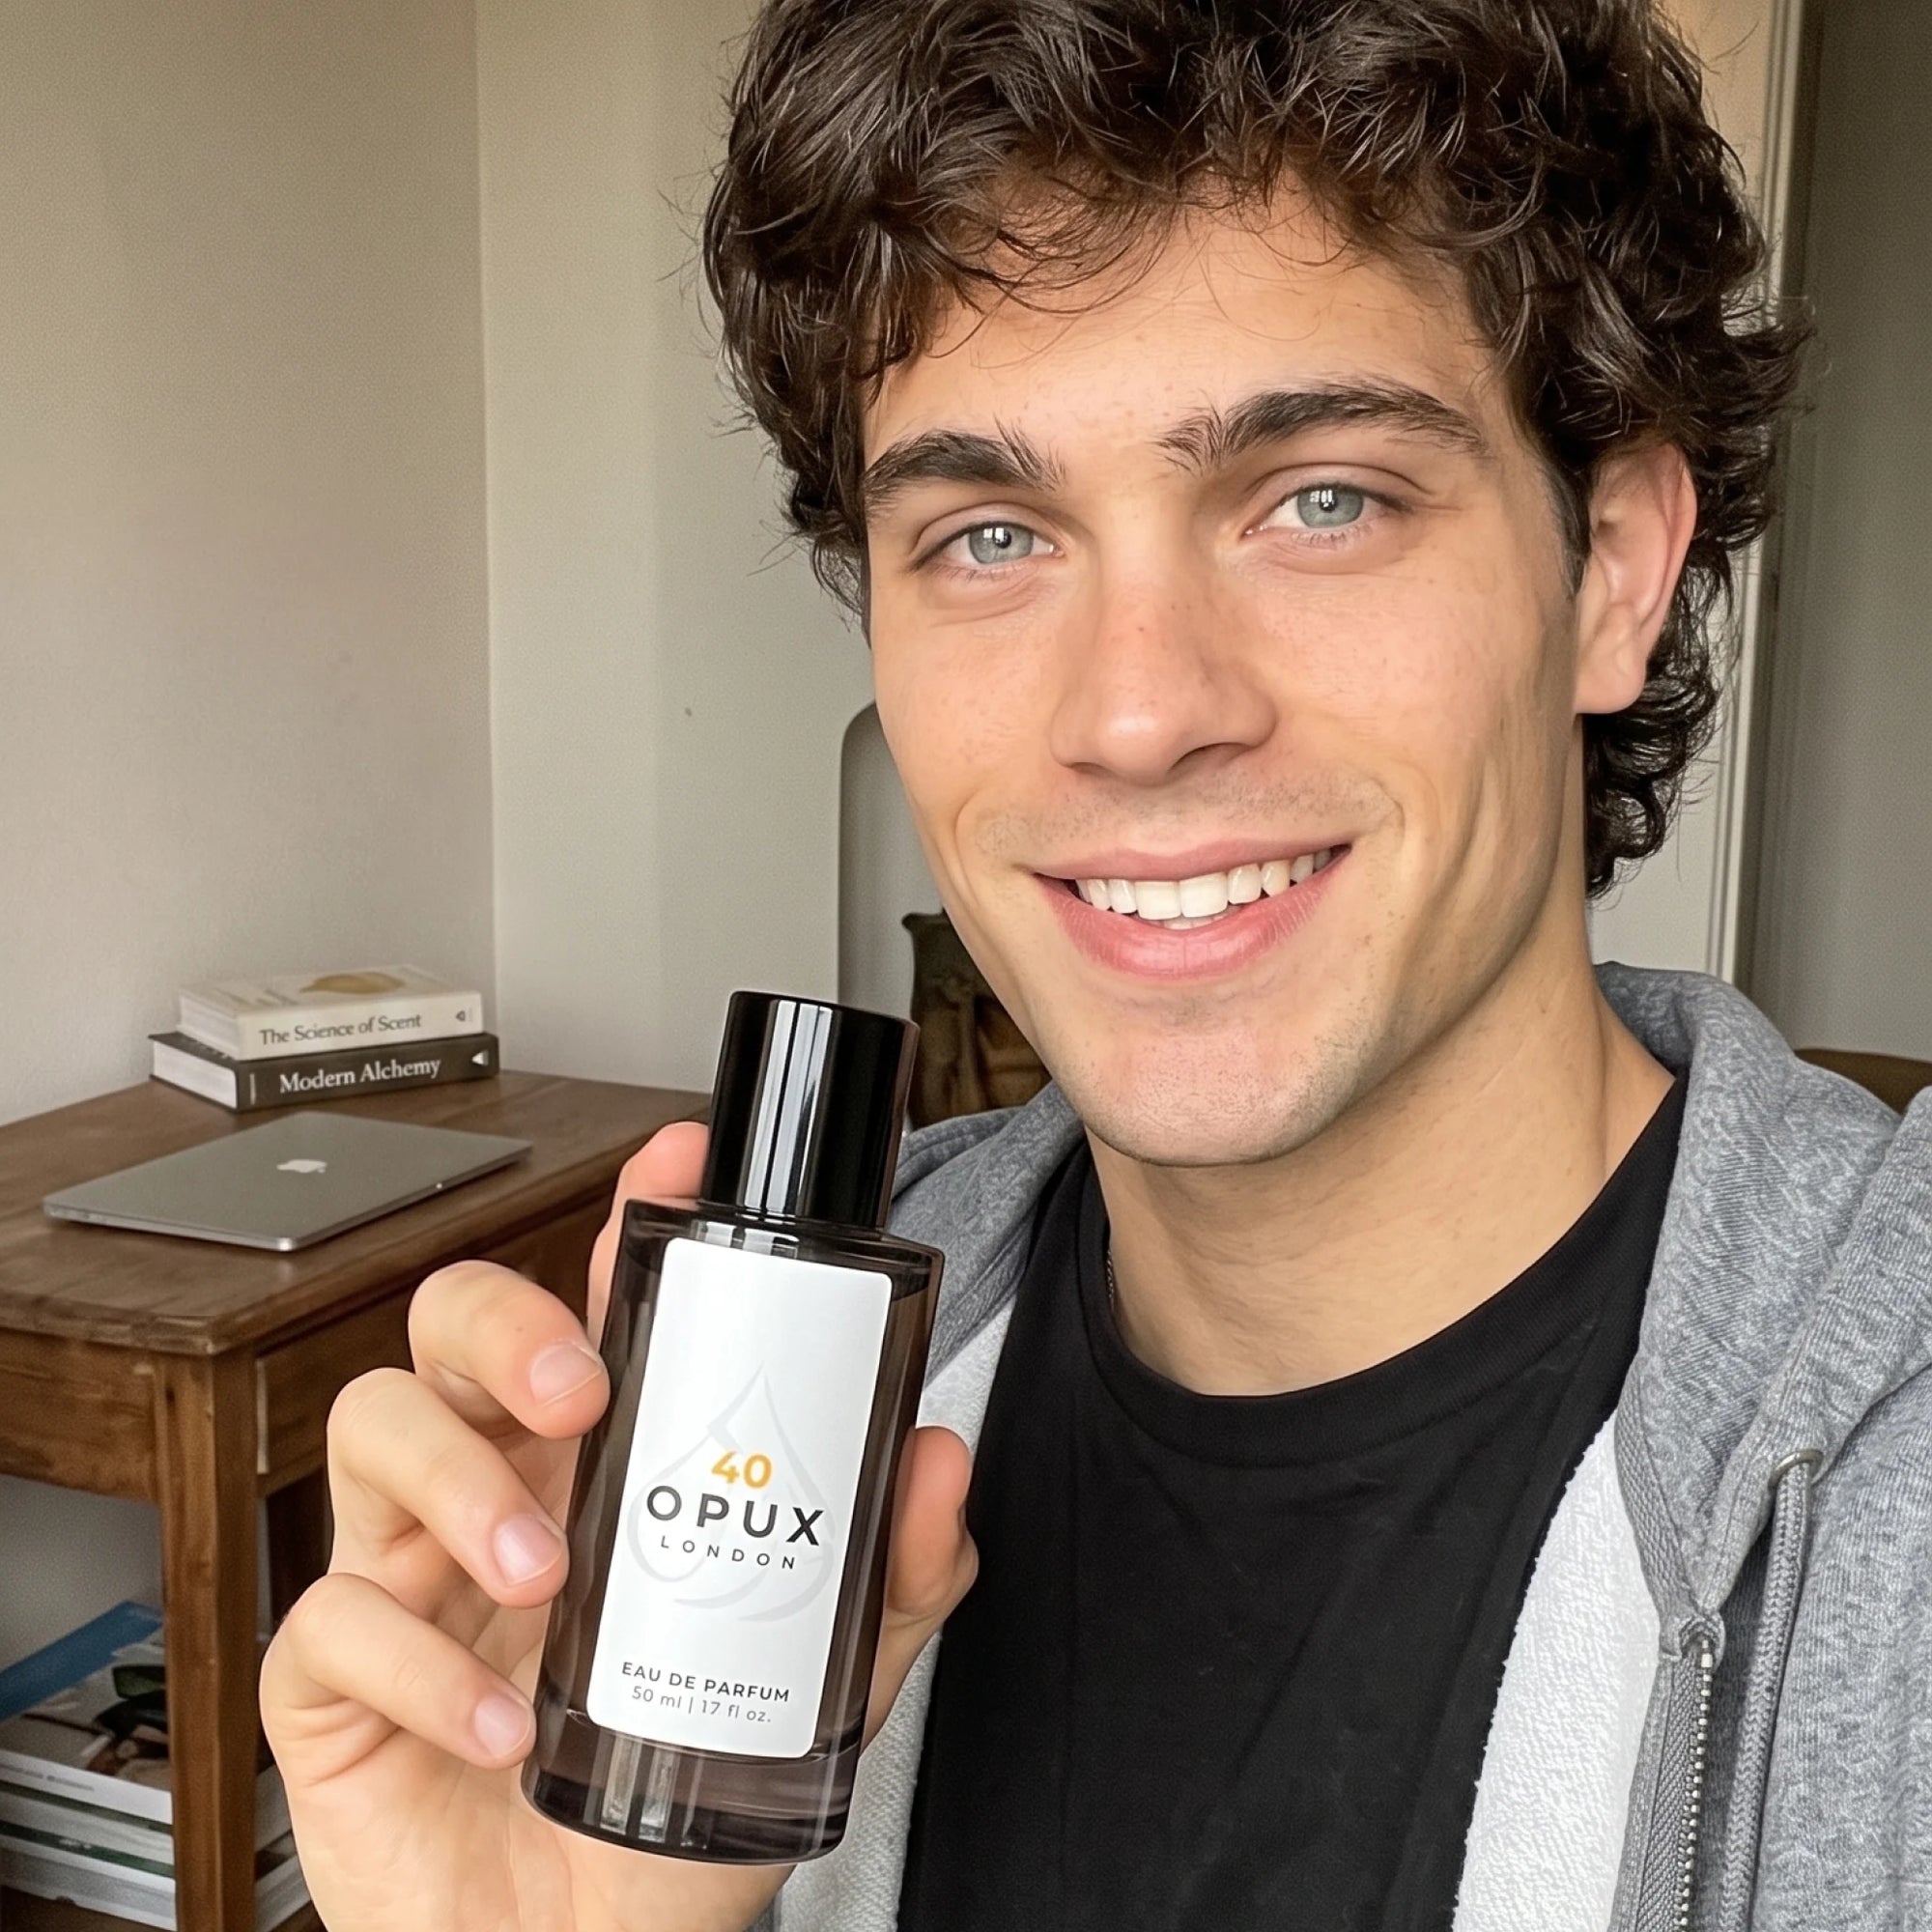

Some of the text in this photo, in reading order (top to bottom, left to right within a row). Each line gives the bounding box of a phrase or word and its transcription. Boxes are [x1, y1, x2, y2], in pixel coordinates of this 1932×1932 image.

[260, 1014, 421, 1045] The Science of Scent
[279, 1059, 441, 1094] Modern Alchemy
[711, 1451, 772, 1489] 40
[646, 1485, 824, 1547] OPUX
[661, 1535, 795, 1570] LONDON
[621, 1662, 790, 1702] EAU DE PARFUM
[632, 1686, 654, 1702] 50
[660, 1694, 682, 1709] ml
[701, 1699, 721, 1716] 17
[727, 1704, 740, 1719] fl
[746, 1710, 772, 1722] oz.
